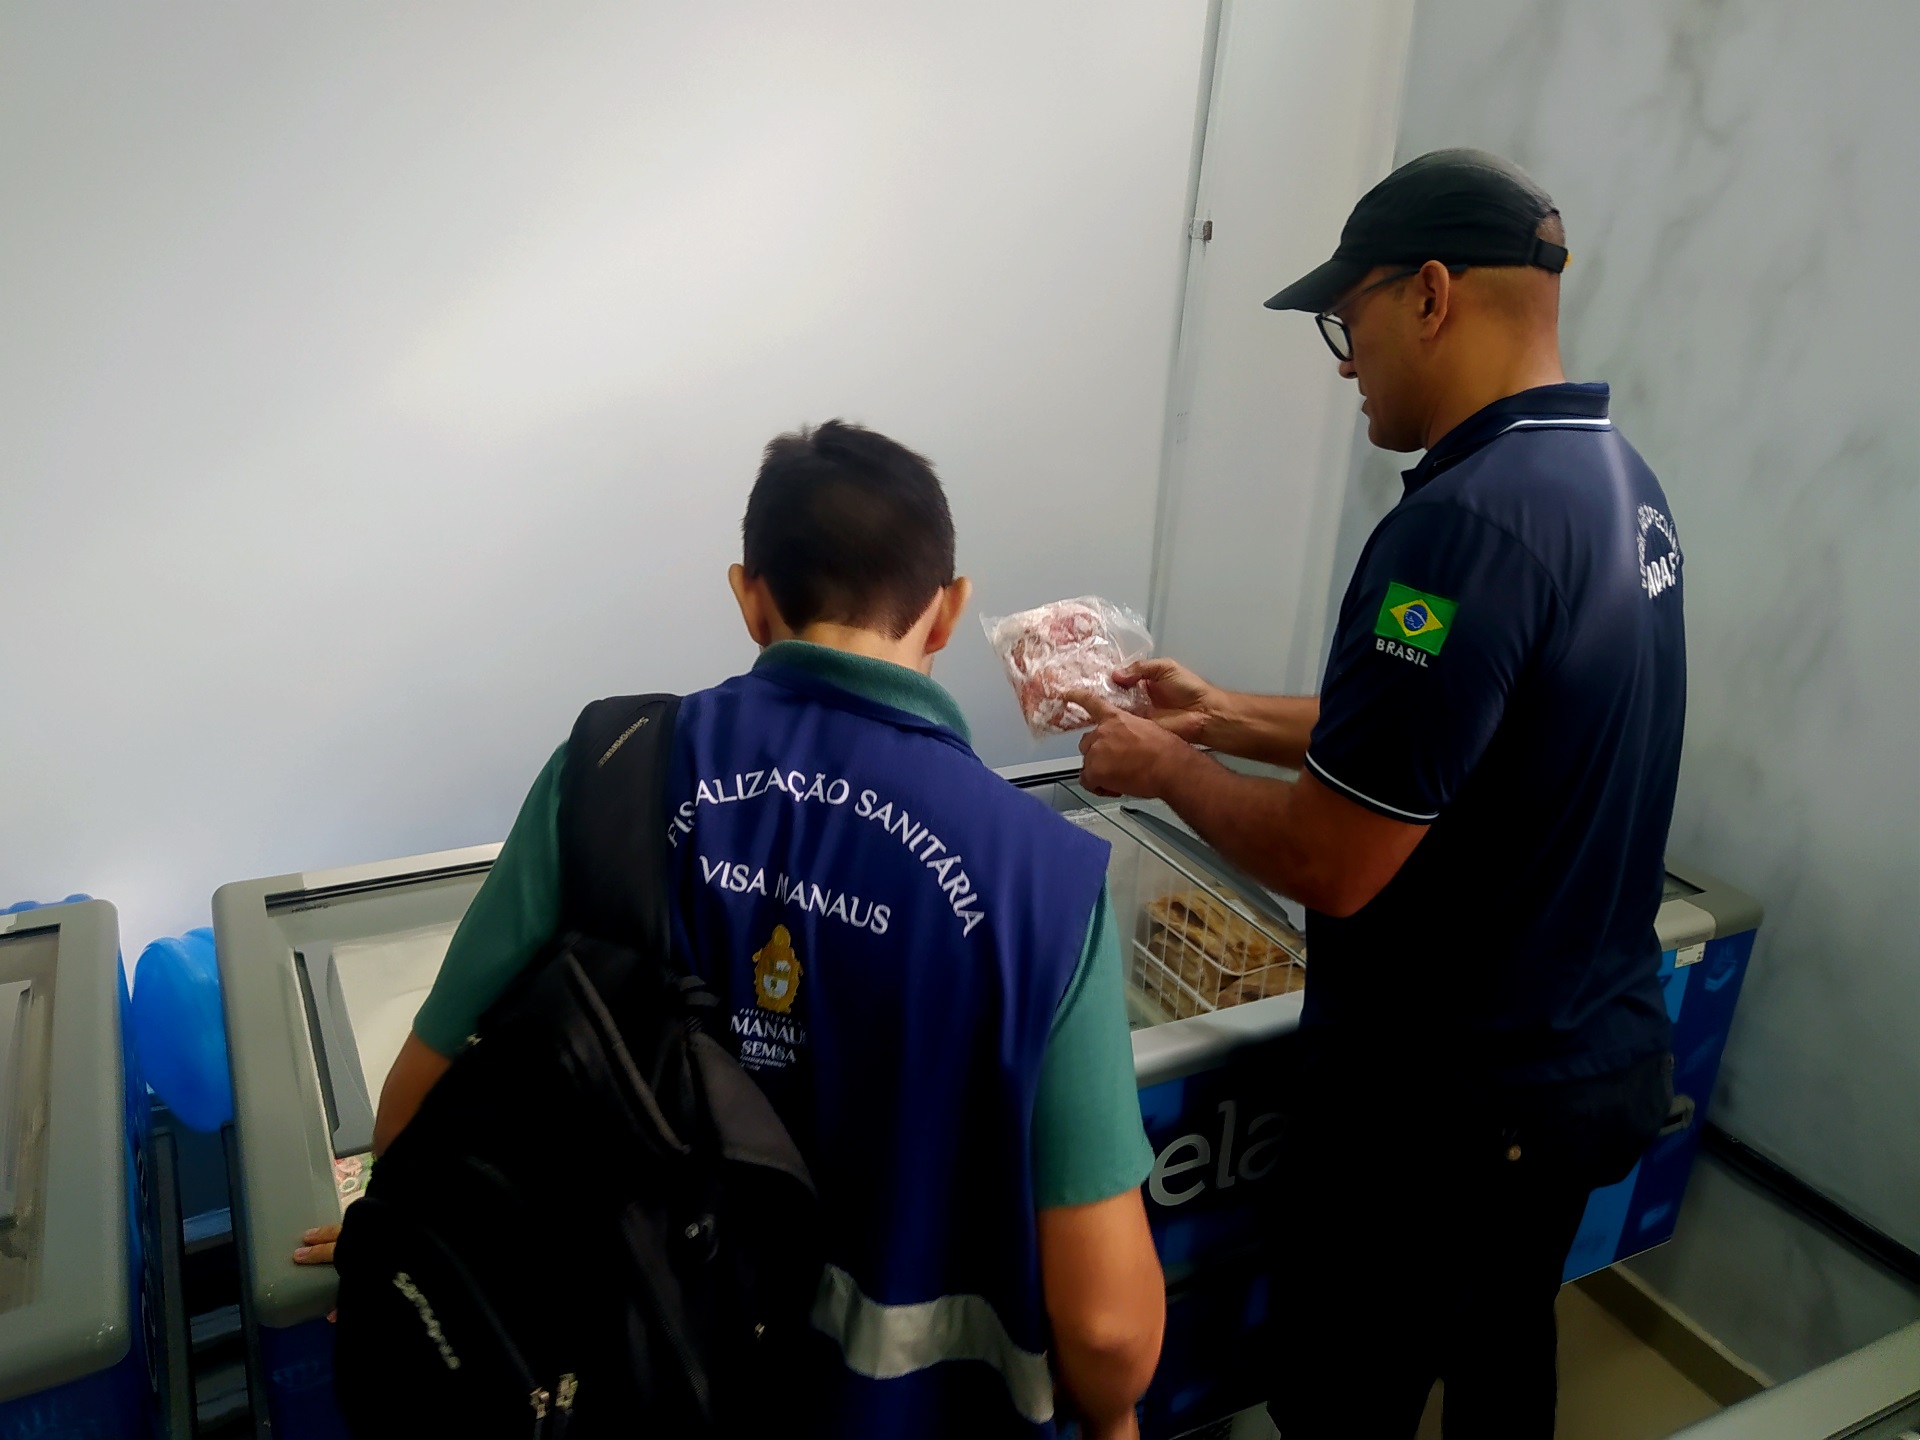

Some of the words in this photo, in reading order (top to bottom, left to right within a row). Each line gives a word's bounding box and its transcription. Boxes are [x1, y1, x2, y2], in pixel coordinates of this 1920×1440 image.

[1375, 637, 1430, 669] BRASIL
[854, 789, 986, 938] SANITÁRIA
[699, 855, 768, 897] VISA
[775, 872, 892, 935] MANAUS
[740, 1039, 797, 1064] SEMSA
